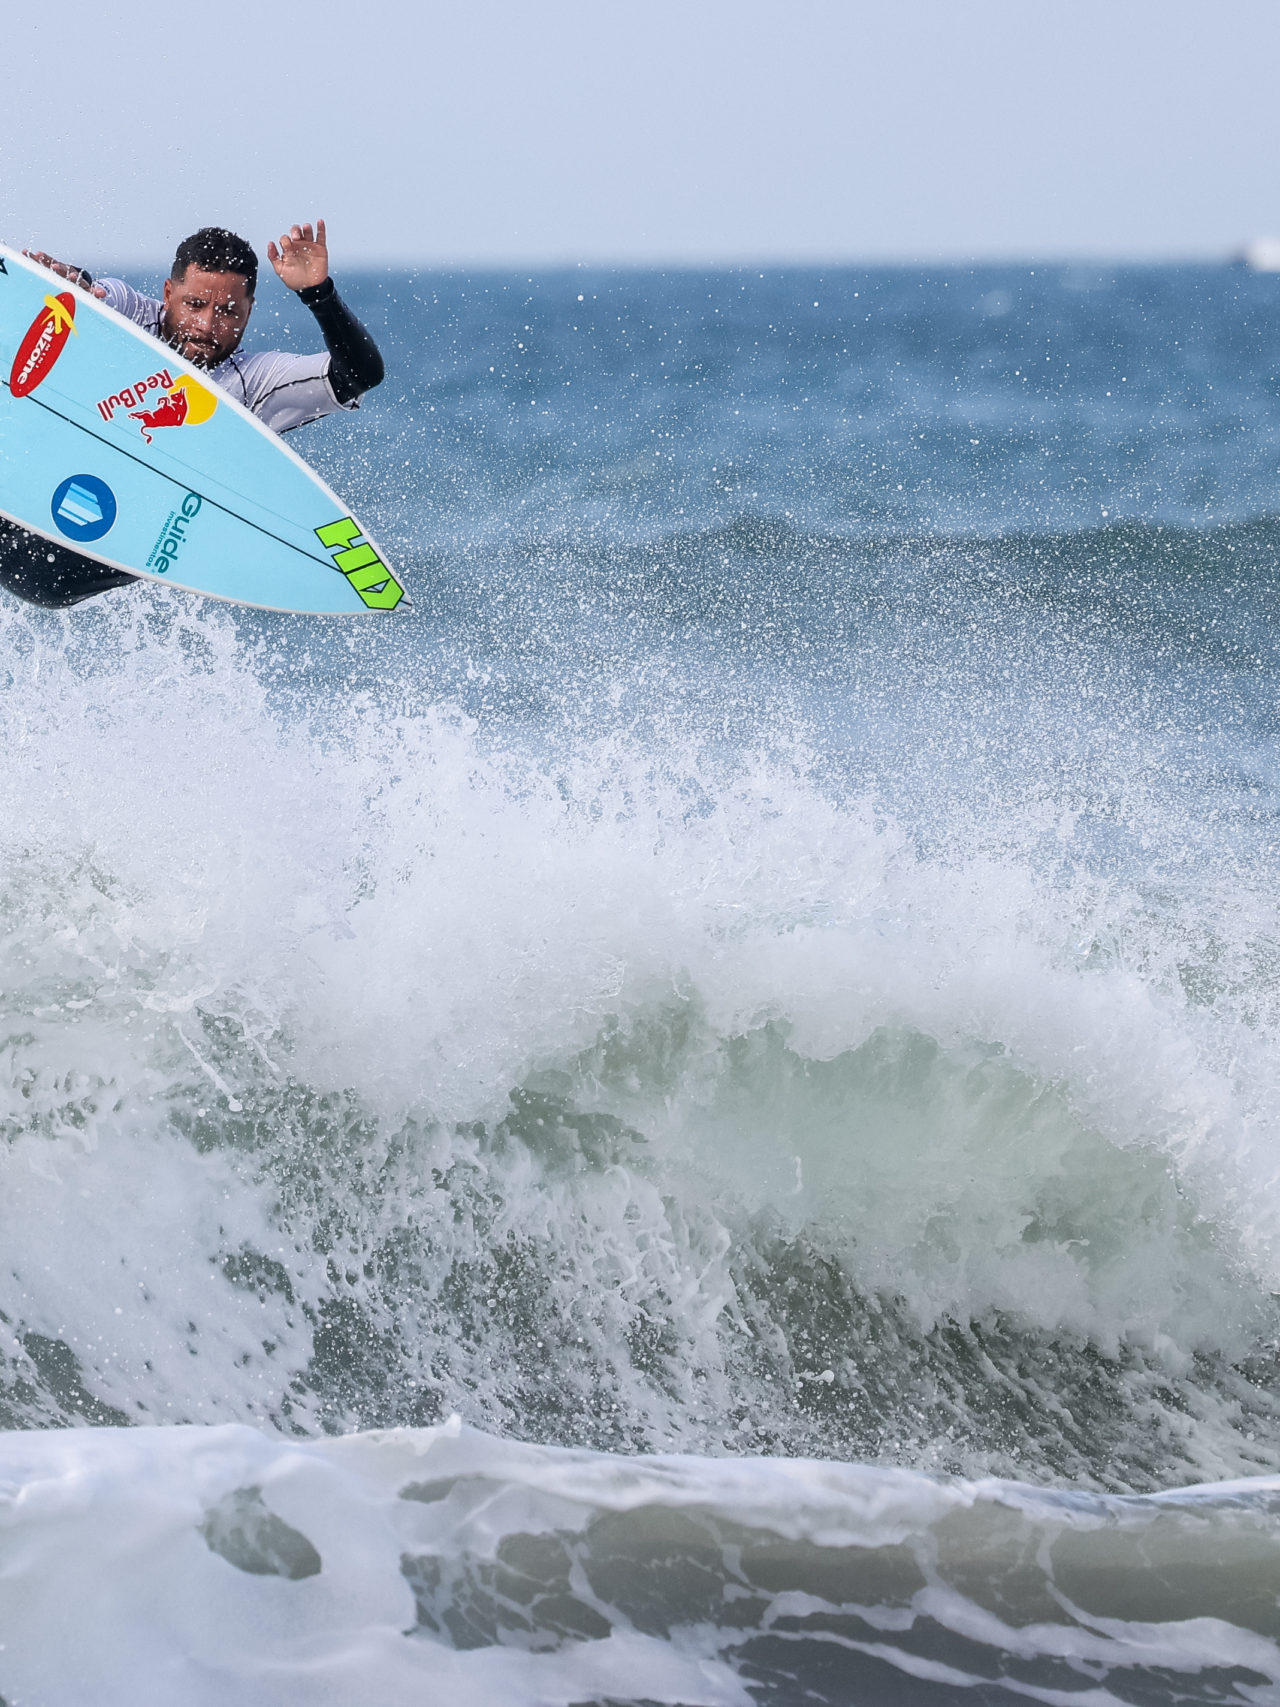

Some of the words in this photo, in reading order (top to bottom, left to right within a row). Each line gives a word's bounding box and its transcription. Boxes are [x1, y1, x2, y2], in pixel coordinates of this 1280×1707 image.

[16, 294, 78, 385] Kalzone
[35, 343, 51, 369] MINI
[97, 388, 137, 421] Bull
[133, 369, 174, 403] Red
[145, 510, 176, 568] investimentos
[154, 492, 202, 574] Guide
